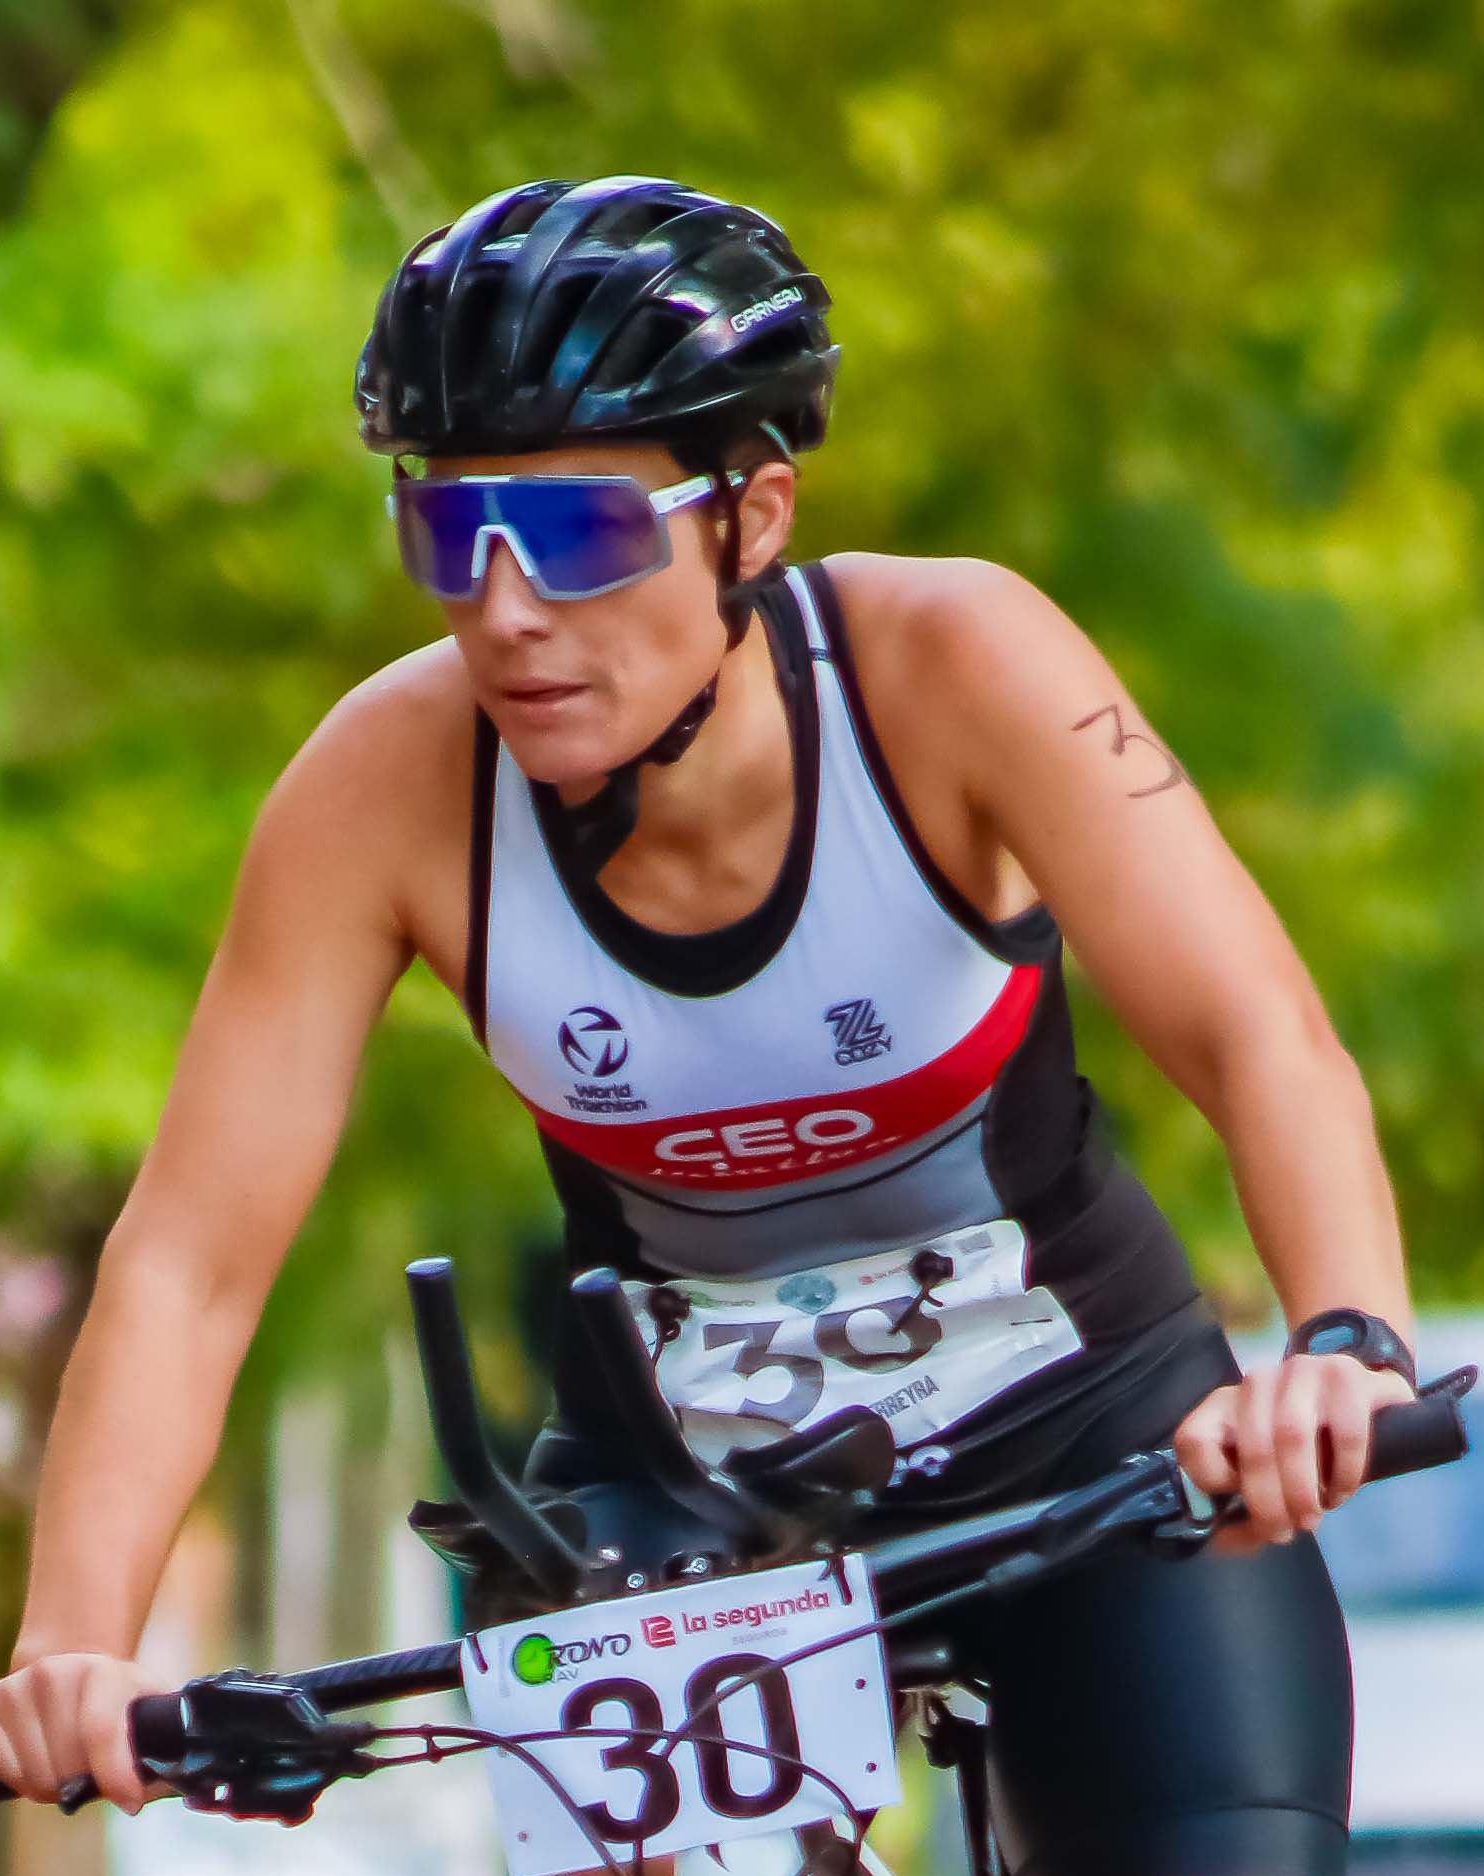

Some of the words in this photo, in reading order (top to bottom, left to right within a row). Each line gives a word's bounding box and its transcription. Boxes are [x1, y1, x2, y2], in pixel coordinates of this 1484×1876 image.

[730, 287, 805, 334] GARNEAU
[574, 1083, 631, 1099] World
[654, 1109, 874, 1163] CEO
[681, 1612, 709, 1635] la
[714, 1588, 831, 1628] segunda
[560, 1652, 804, 1844] 30
